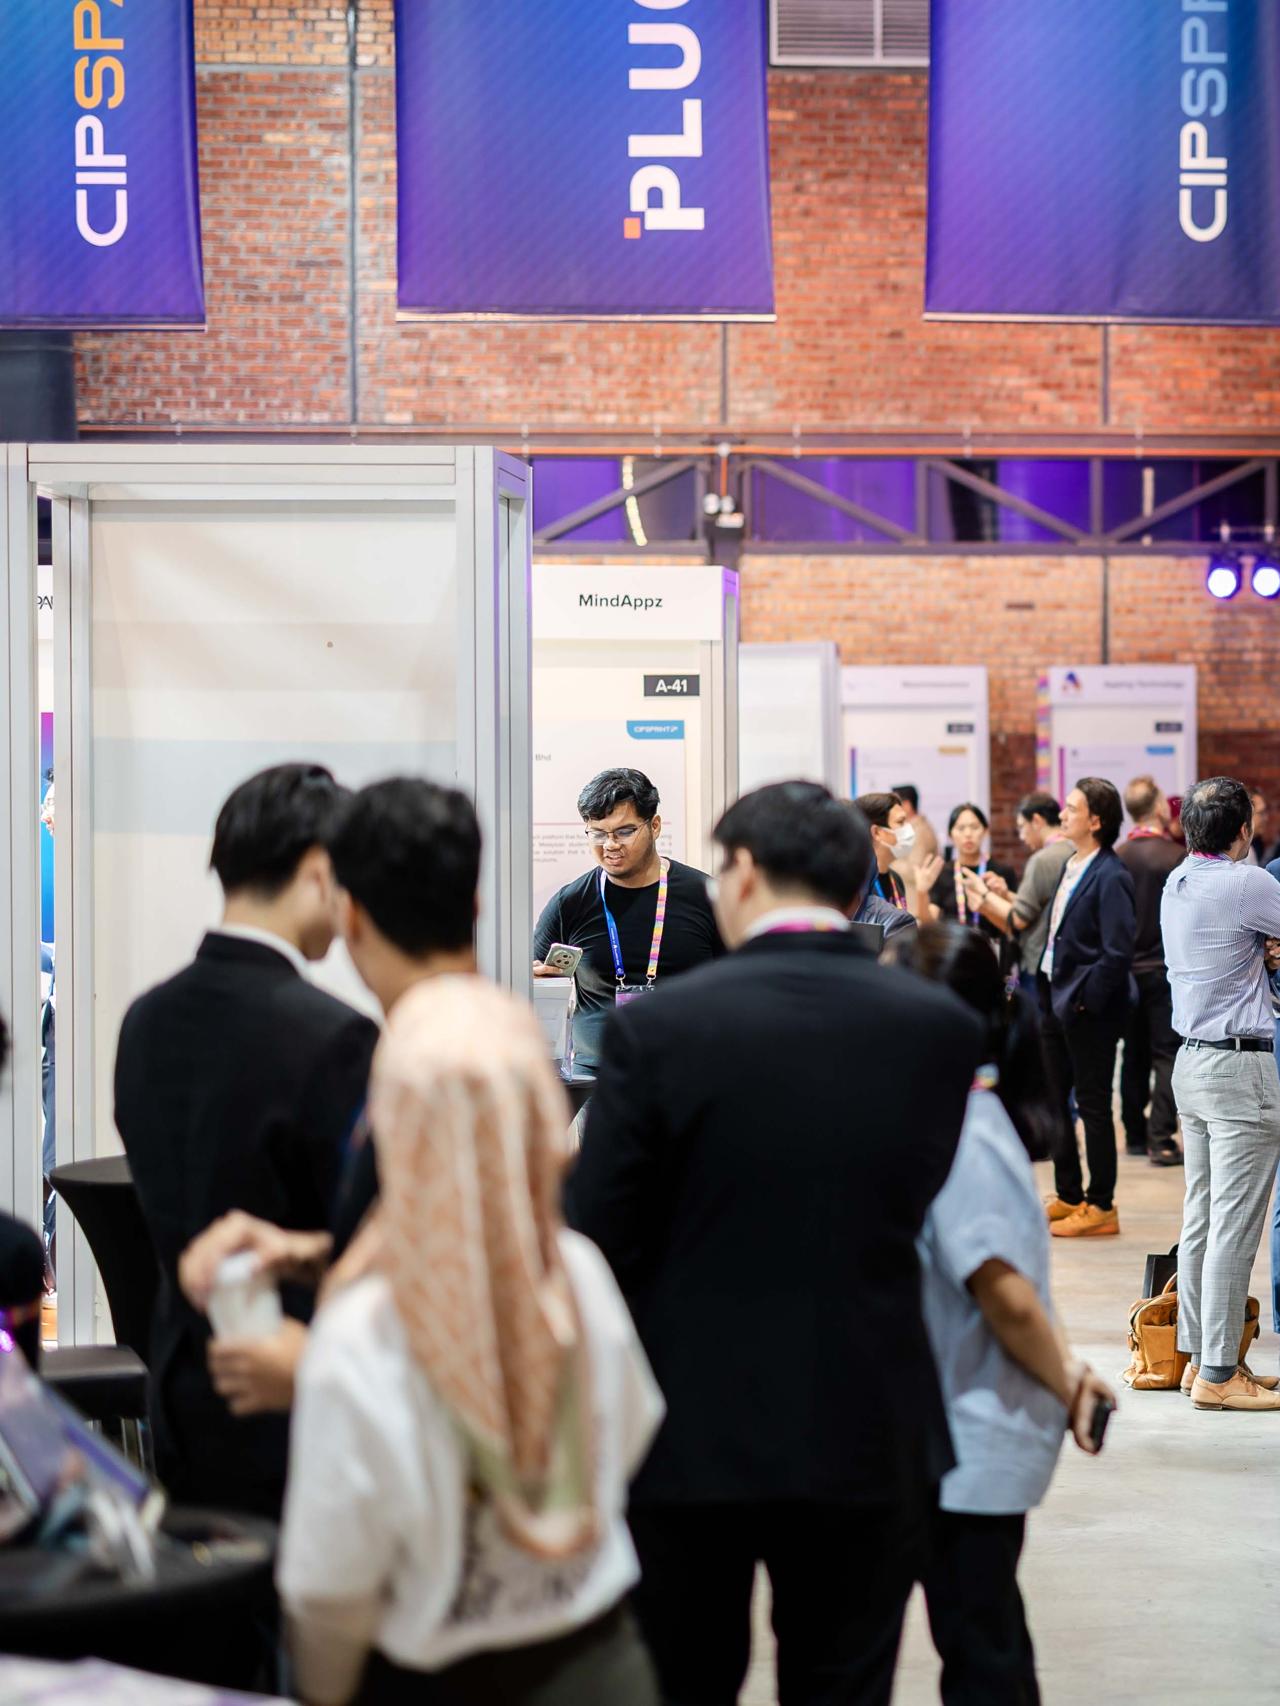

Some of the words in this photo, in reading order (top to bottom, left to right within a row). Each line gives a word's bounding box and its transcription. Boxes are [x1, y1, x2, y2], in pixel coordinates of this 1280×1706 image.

[74, 0, 128, 247] CIPSP
[626, 0, 705, 232] PLU
[1179, 0, 1228, 242] CIPSP
[579, 593, 663, 611] MindAppz
[655, 678, 688, 693] A-41
